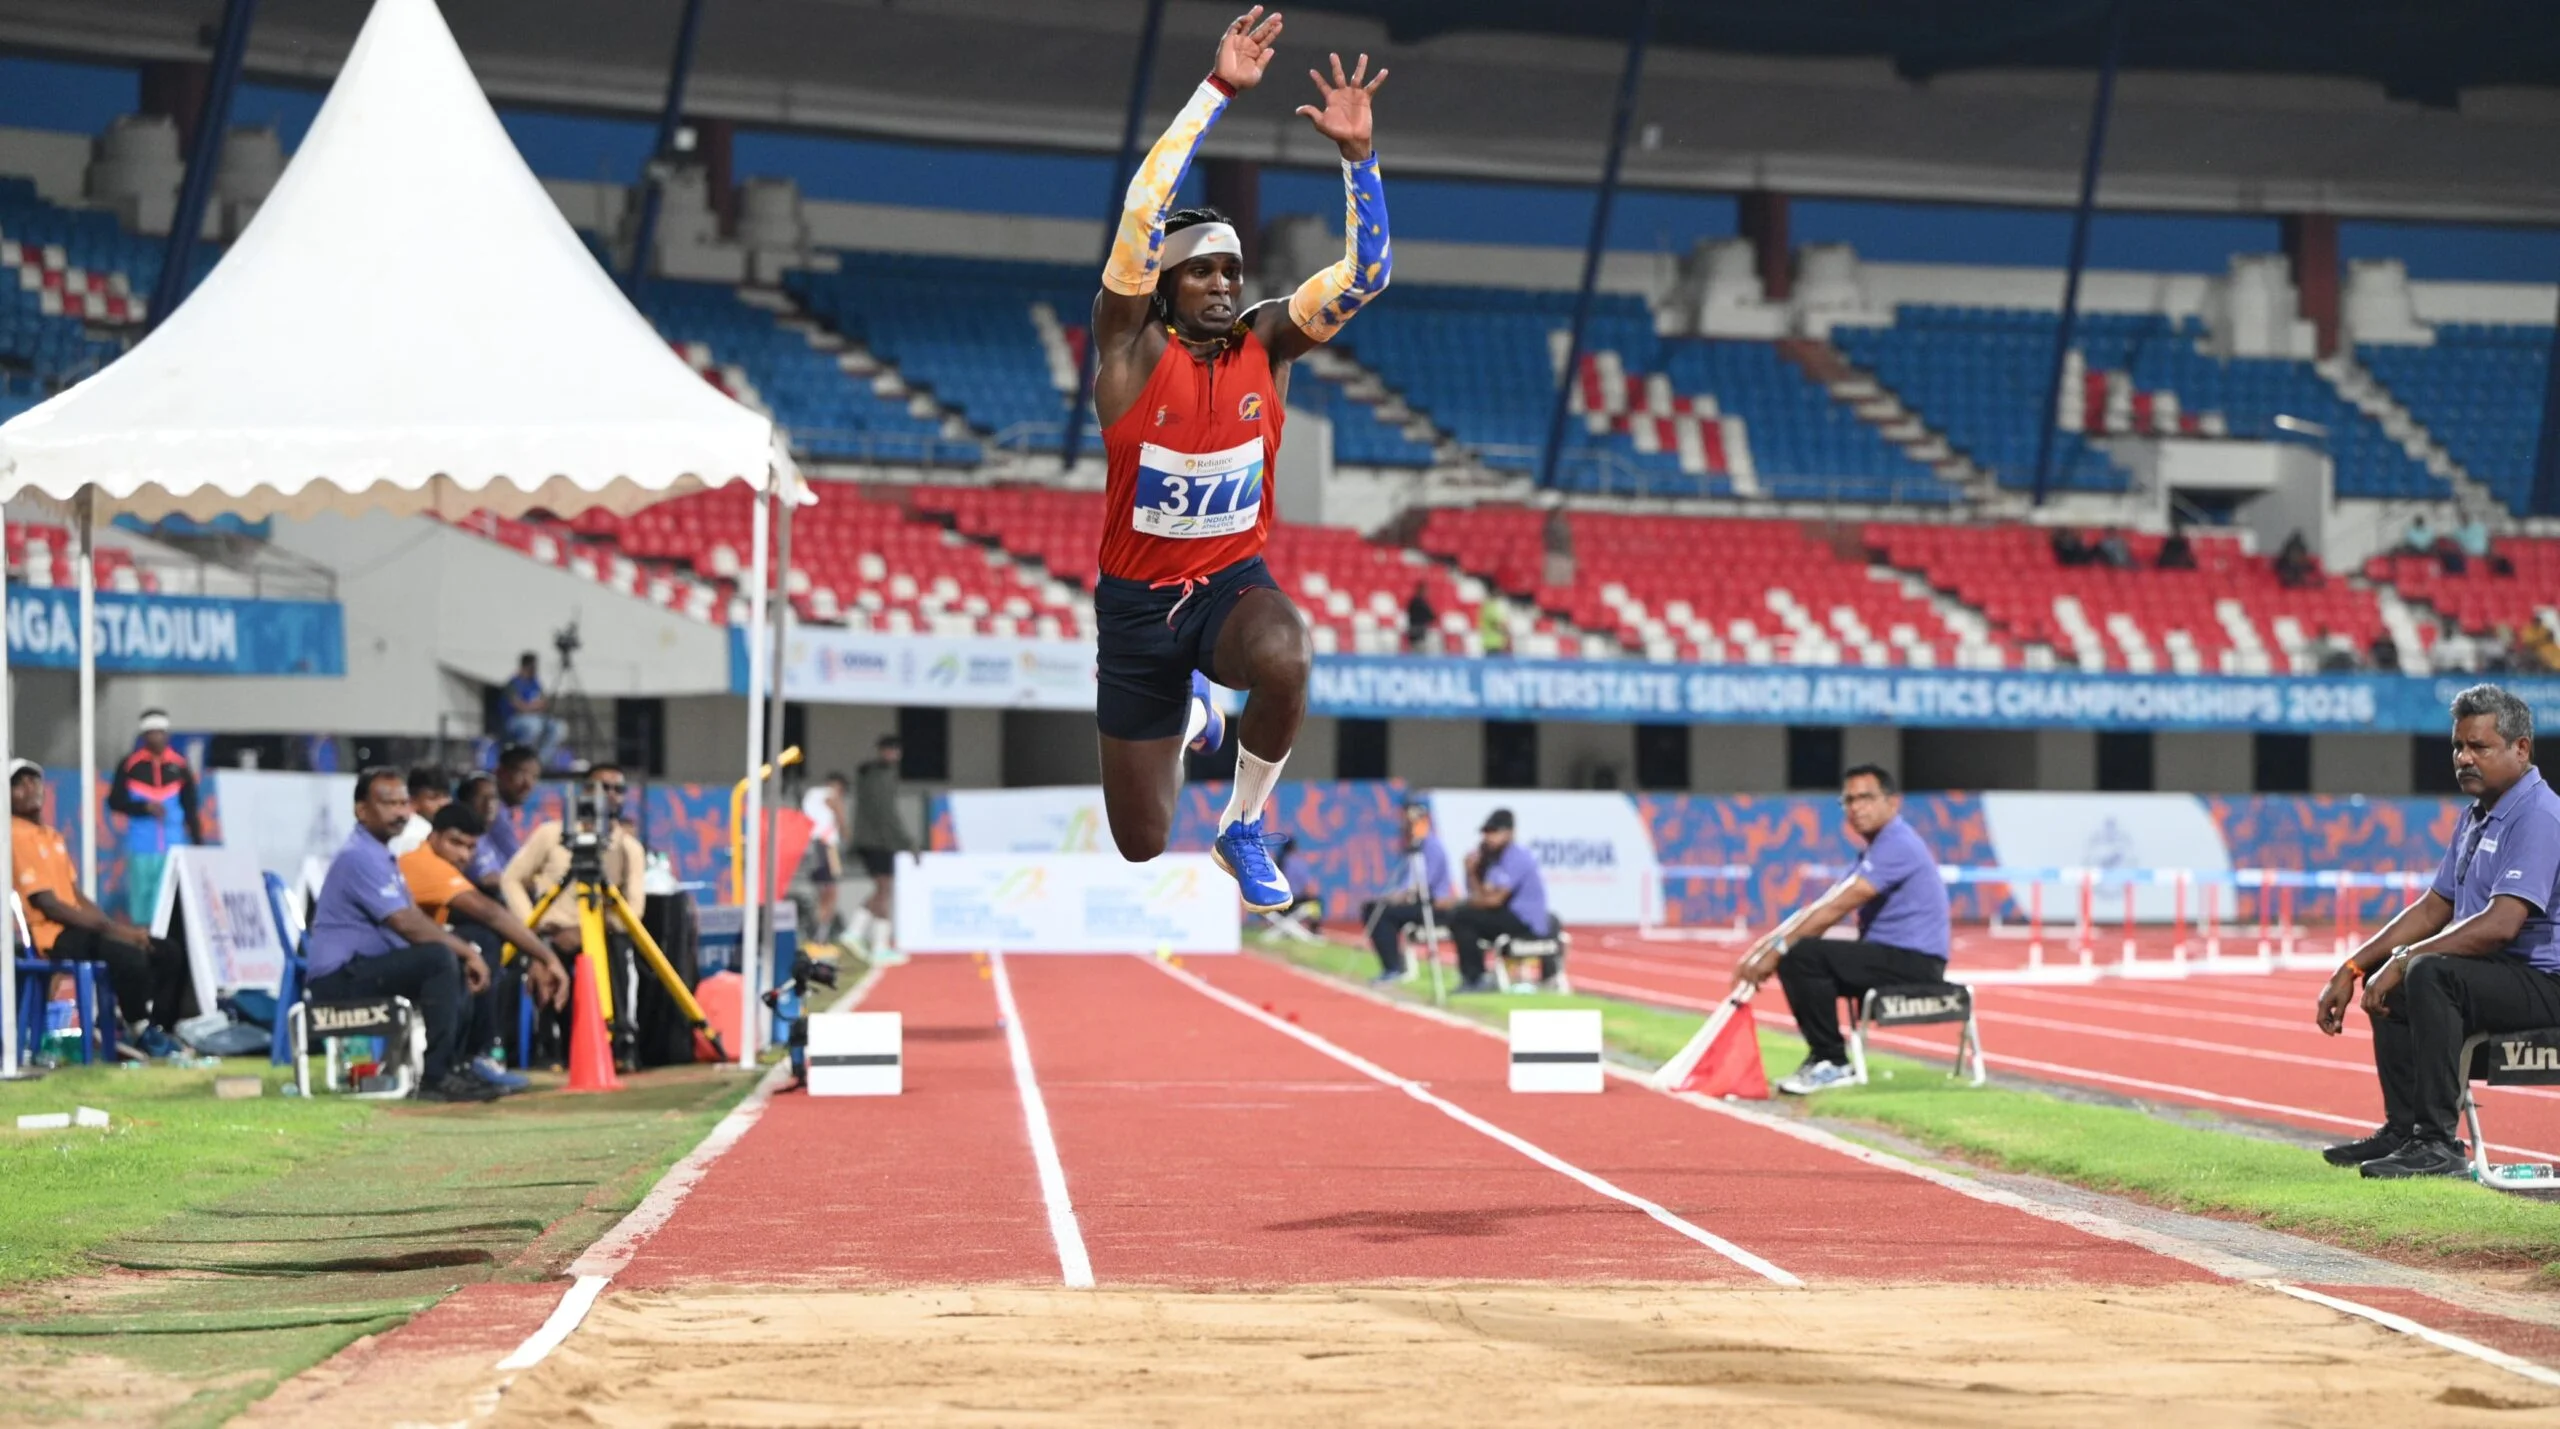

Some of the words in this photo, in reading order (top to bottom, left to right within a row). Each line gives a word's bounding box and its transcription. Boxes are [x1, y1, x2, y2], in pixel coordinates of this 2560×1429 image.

[1197, 457, 1233, 469] Reliance
[1159, 467, 1250, 516] 377
[1203, 514, 1235, 523] INDIAN
[93, 604, 237, 661] STADIUM
[1311, 664, 1478, 707] NATIONAL
[1481, 668, 1679, 711] INTERSTATE
[1686, 672, 1809, 713] SENIOR
[1811, 676, 1993, 717] ATHLETICS
[1997, 680, 2281, 722] CHAMPIONSHIPS
[311, 1004, 391, 1032] Vinex
